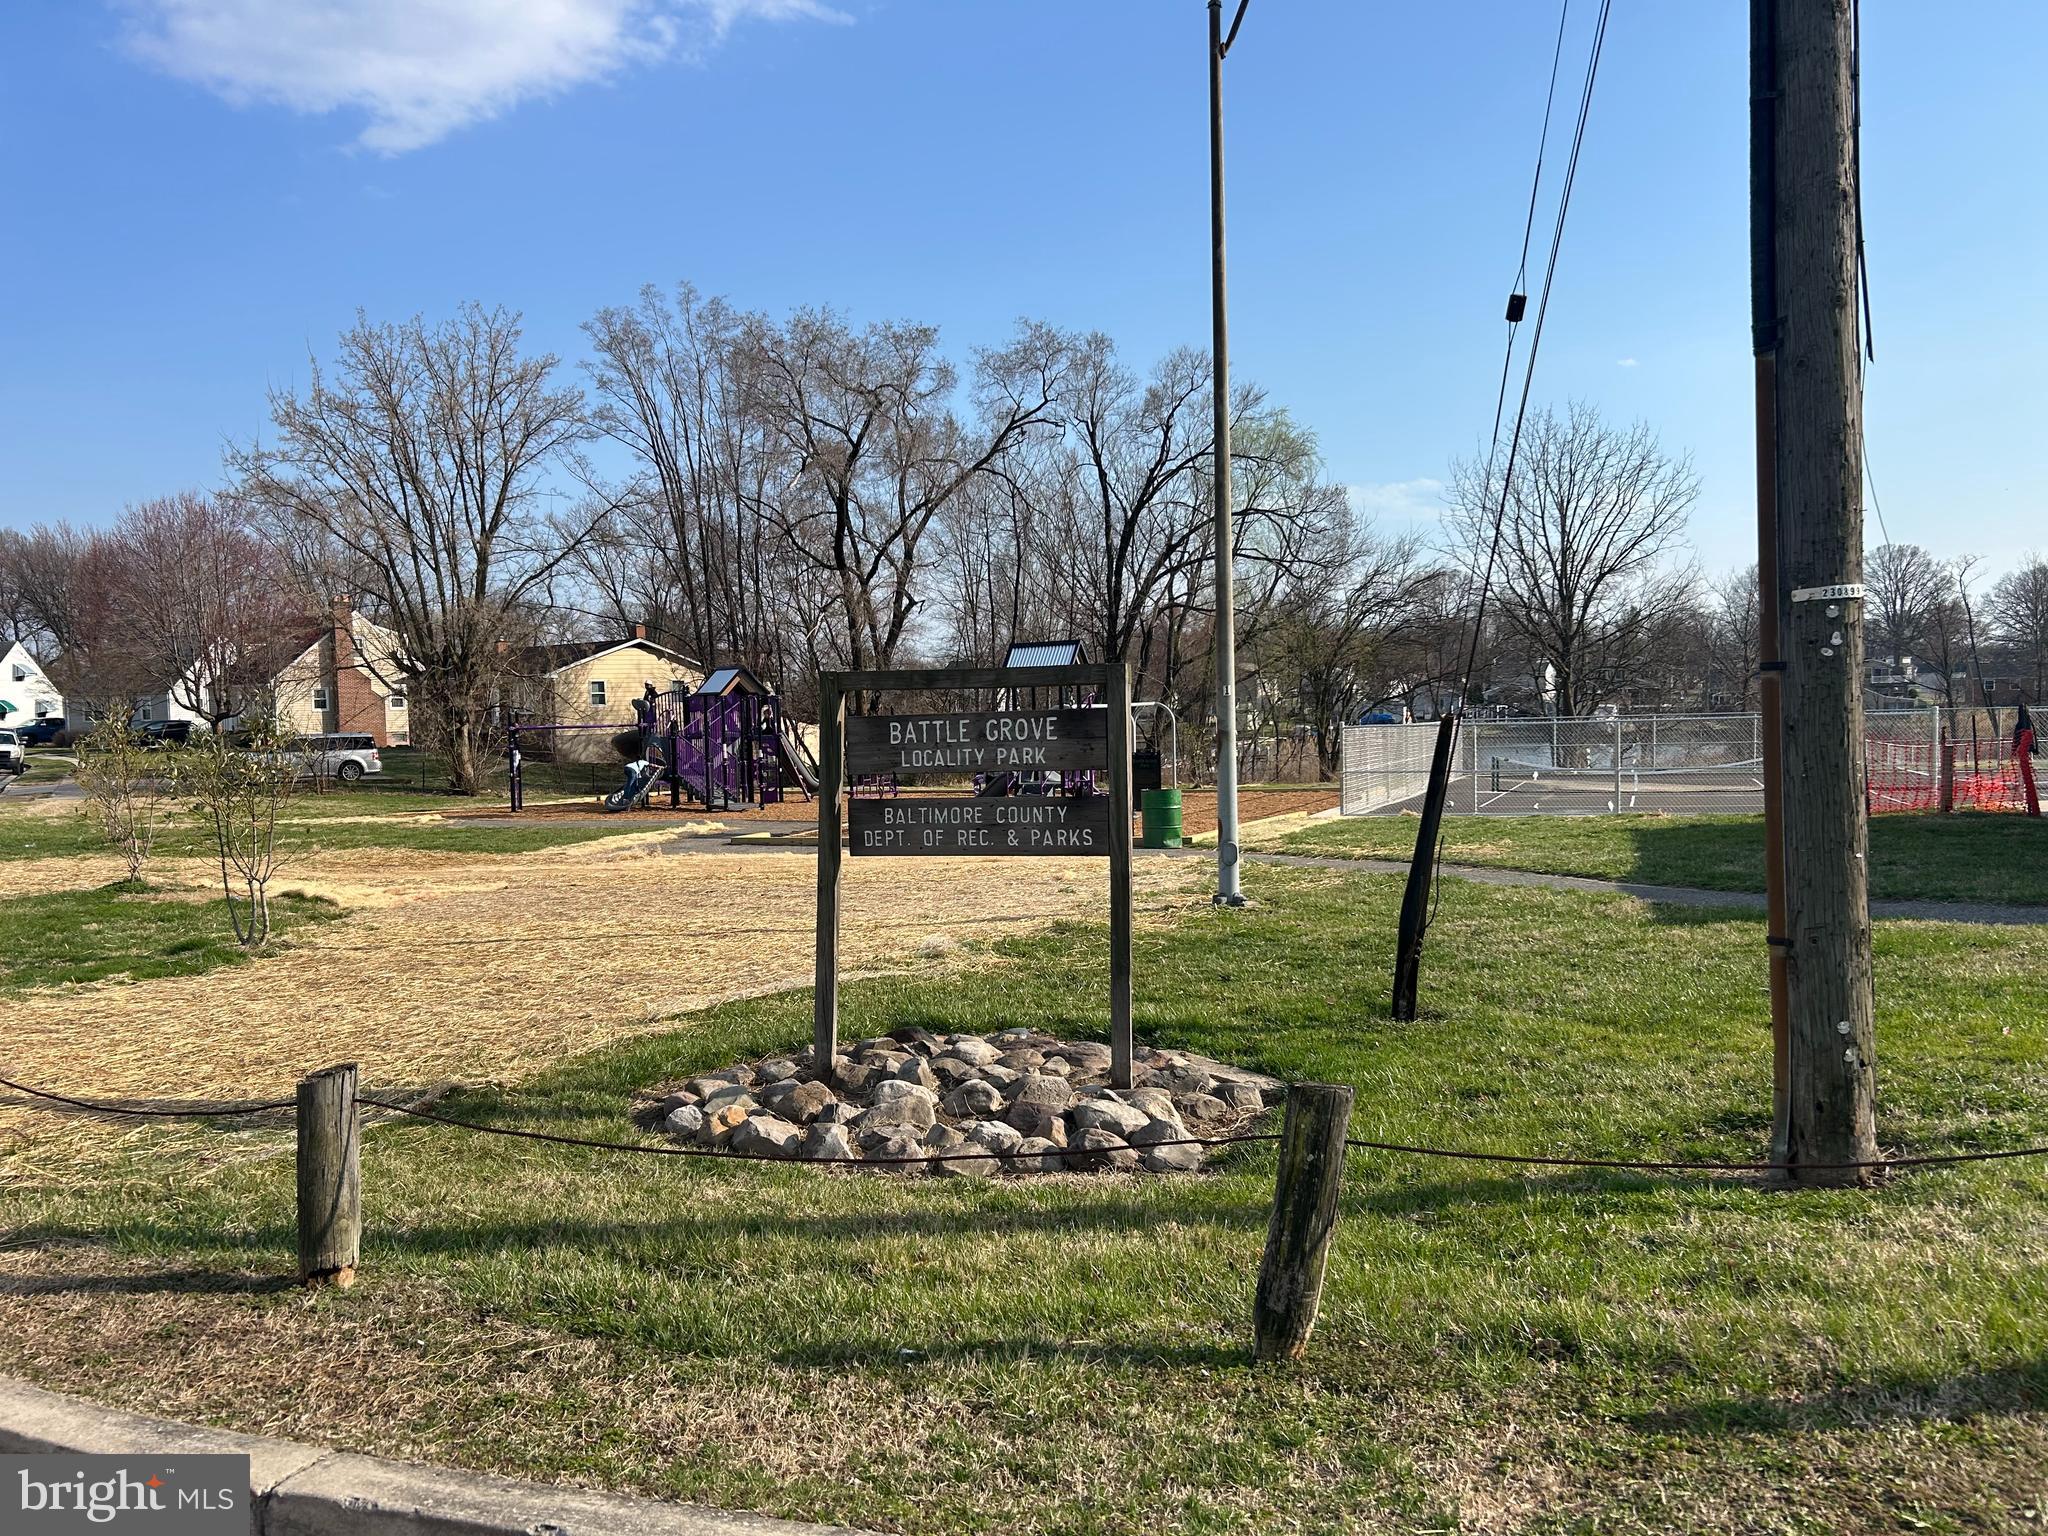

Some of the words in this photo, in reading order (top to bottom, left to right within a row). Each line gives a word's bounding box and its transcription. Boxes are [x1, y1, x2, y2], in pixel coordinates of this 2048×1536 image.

[889, 719, 971, 745] BATTLE
[985, 716, 1058, 741] GROVE
[901, 748, 985, 768] LOCALITY
[996, 747, 1047, 766] PARK
[884, 807, 983, 825] BALTIMORE
[996, 805, 1068, 824] COUNTY
[864, 830, 911, 847] DEPT.
[923, 829, 944, 847] OF
[957, 829, 995, 847] REC.
[1007, 829, 1020, 847] &
[1031, 828, 1094, 847] PARKS
